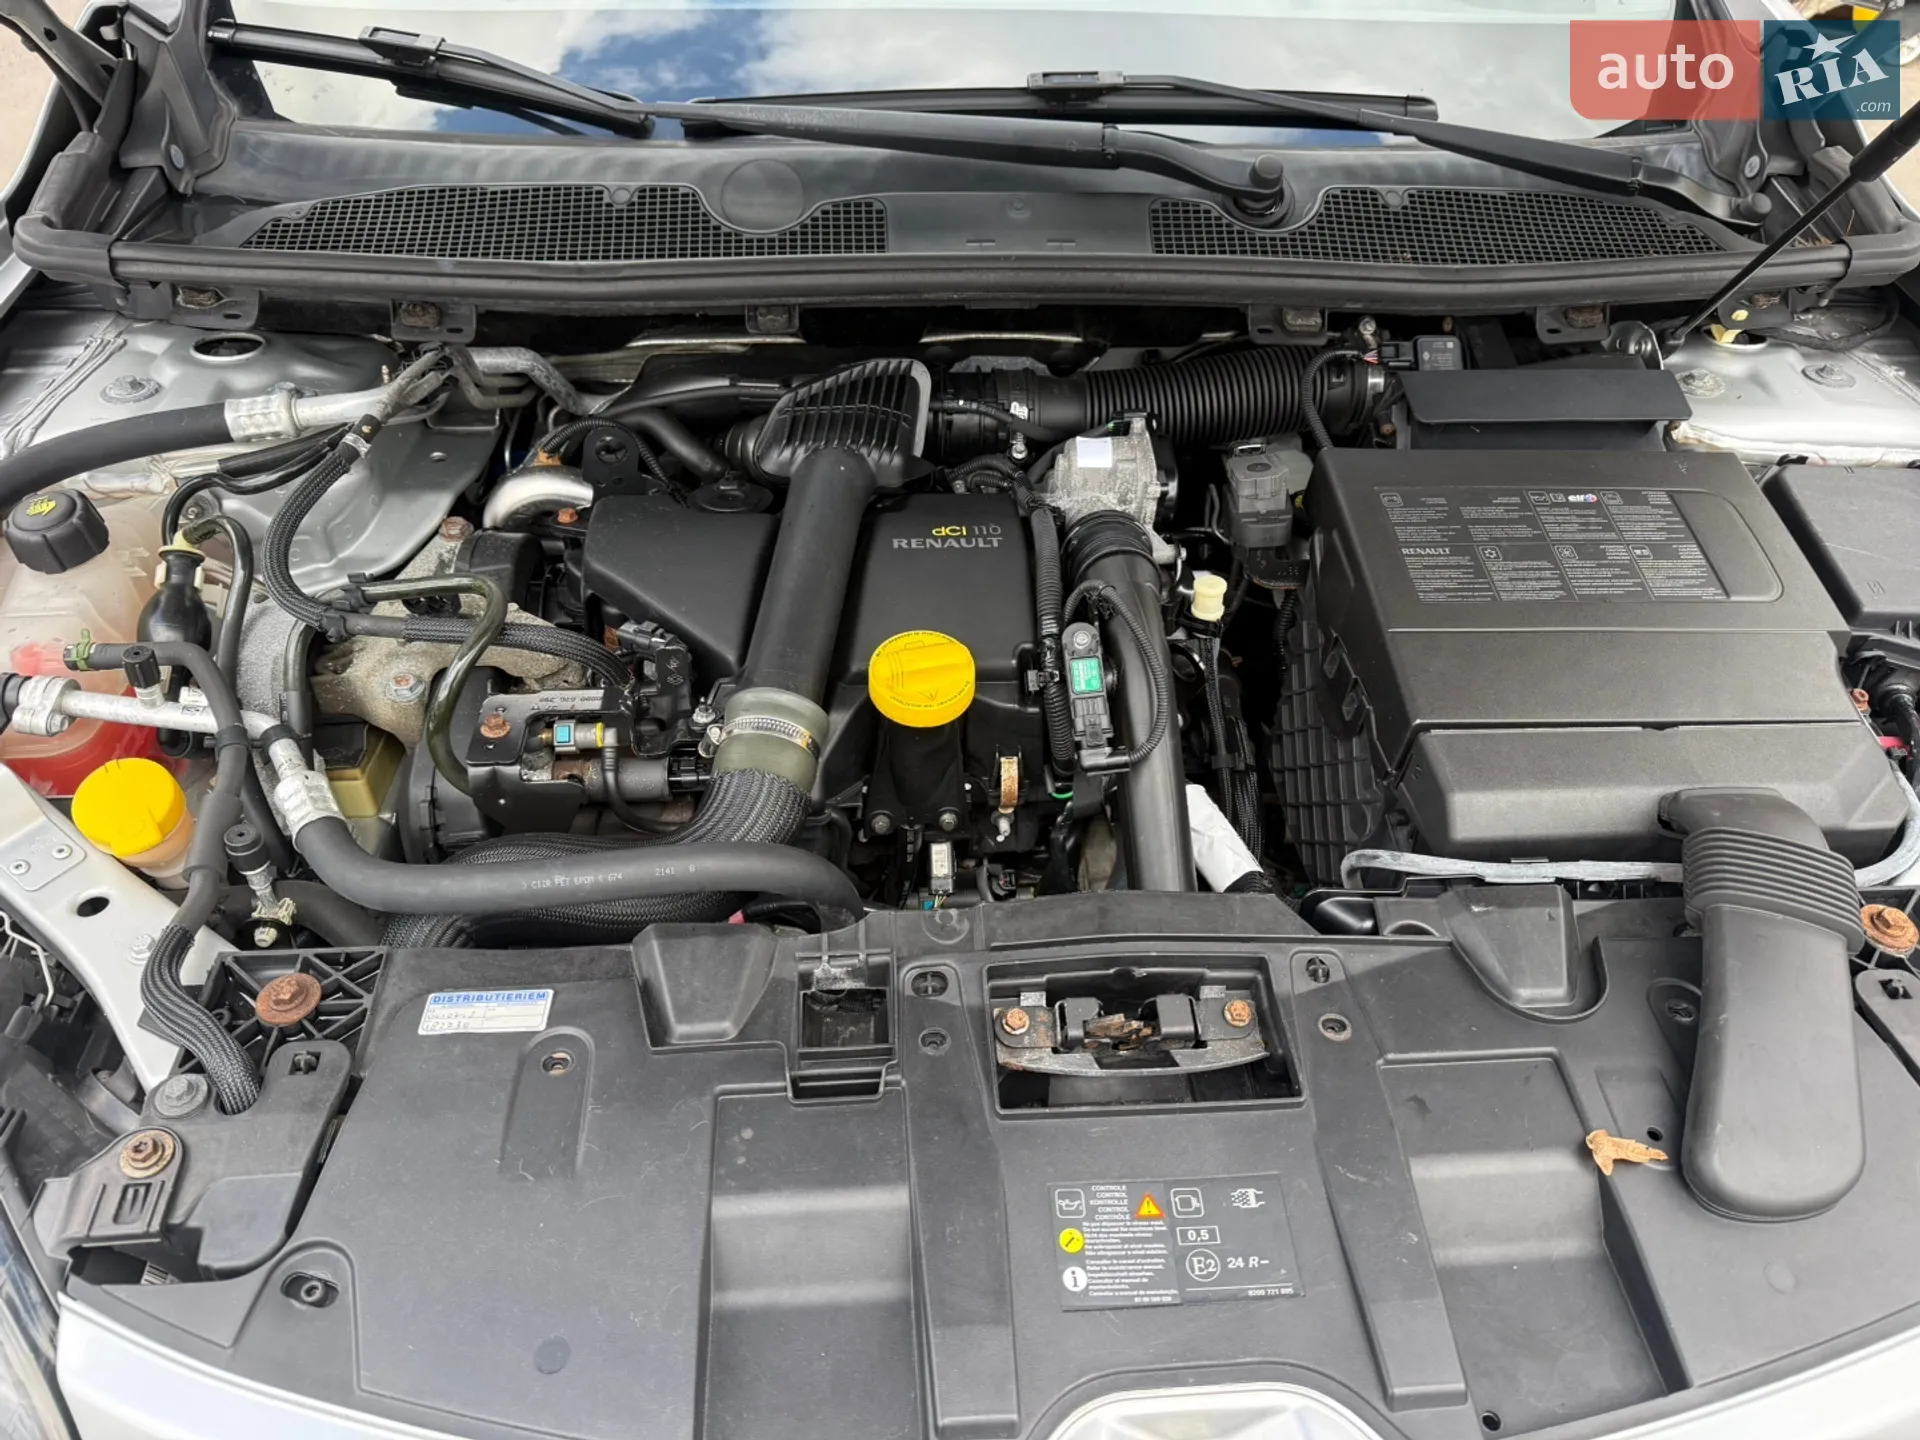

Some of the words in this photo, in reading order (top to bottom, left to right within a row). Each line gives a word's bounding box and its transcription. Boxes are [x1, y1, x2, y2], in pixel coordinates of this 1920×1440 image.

[1567, 494, 1587, 503] elf
[972, 525, 1002, 535] 110
[892, 537, 1003, 549] RENAULT
[1401, 547, 1451, 555] RENAULT
[433, 992, 547, 1004] DISTRIBUTIERIEM
[1187, 1229, 1209, 1242] 0,5
[1191, 1257, 1217, 1275] E2
[1226, 1256, 1245, 1269] 24
